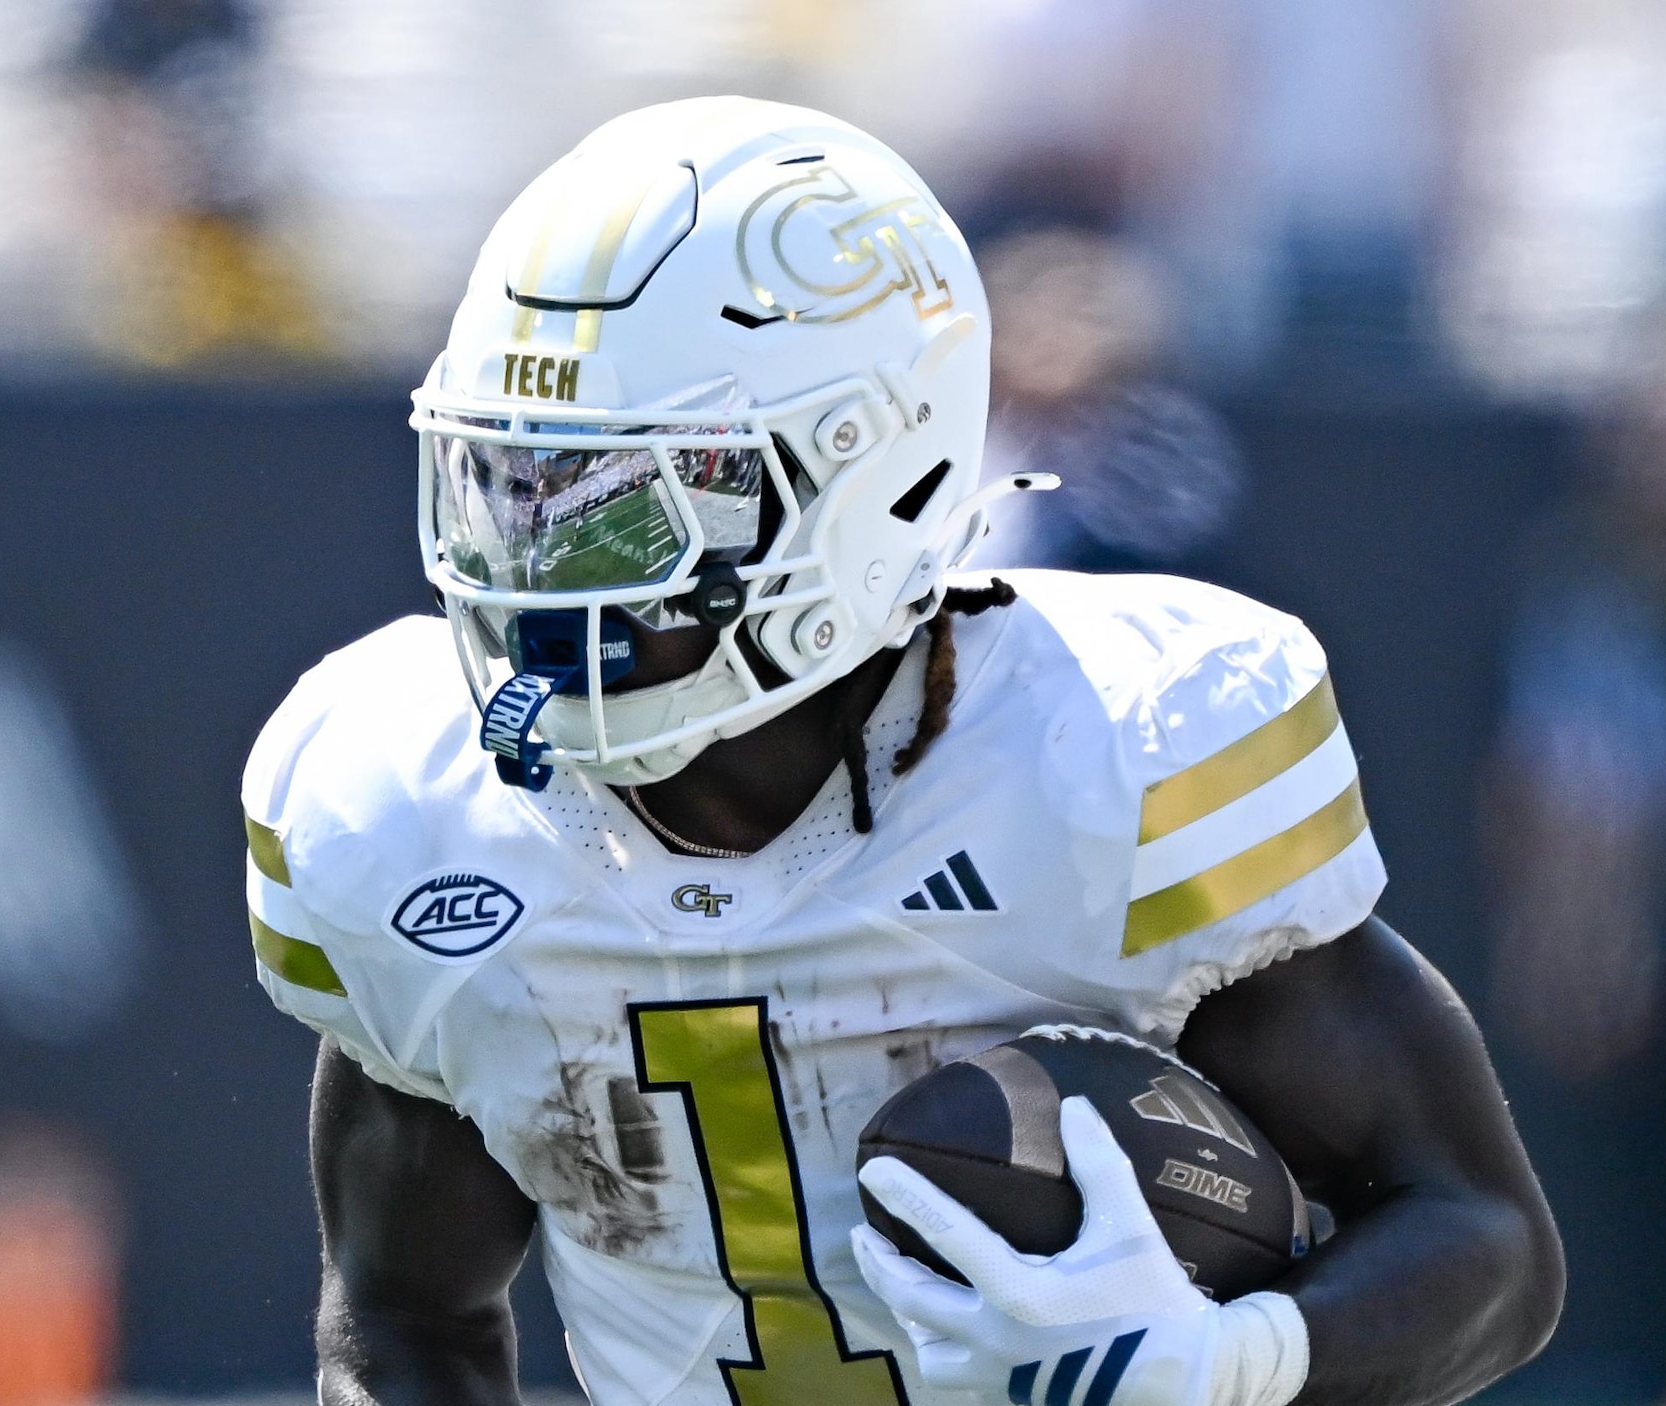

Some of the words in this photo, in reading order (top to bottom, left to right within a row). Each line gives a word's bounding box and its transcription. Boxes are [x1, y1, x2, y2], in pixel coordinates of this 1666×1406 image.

[736, 167, 954, 324] GT
[504, 353, 581, 402] TECH
[412, 891, 501, 928] ACC
[671, 884, 732, 917] GT
[1156, 1159, 1252, 1213] DIME
